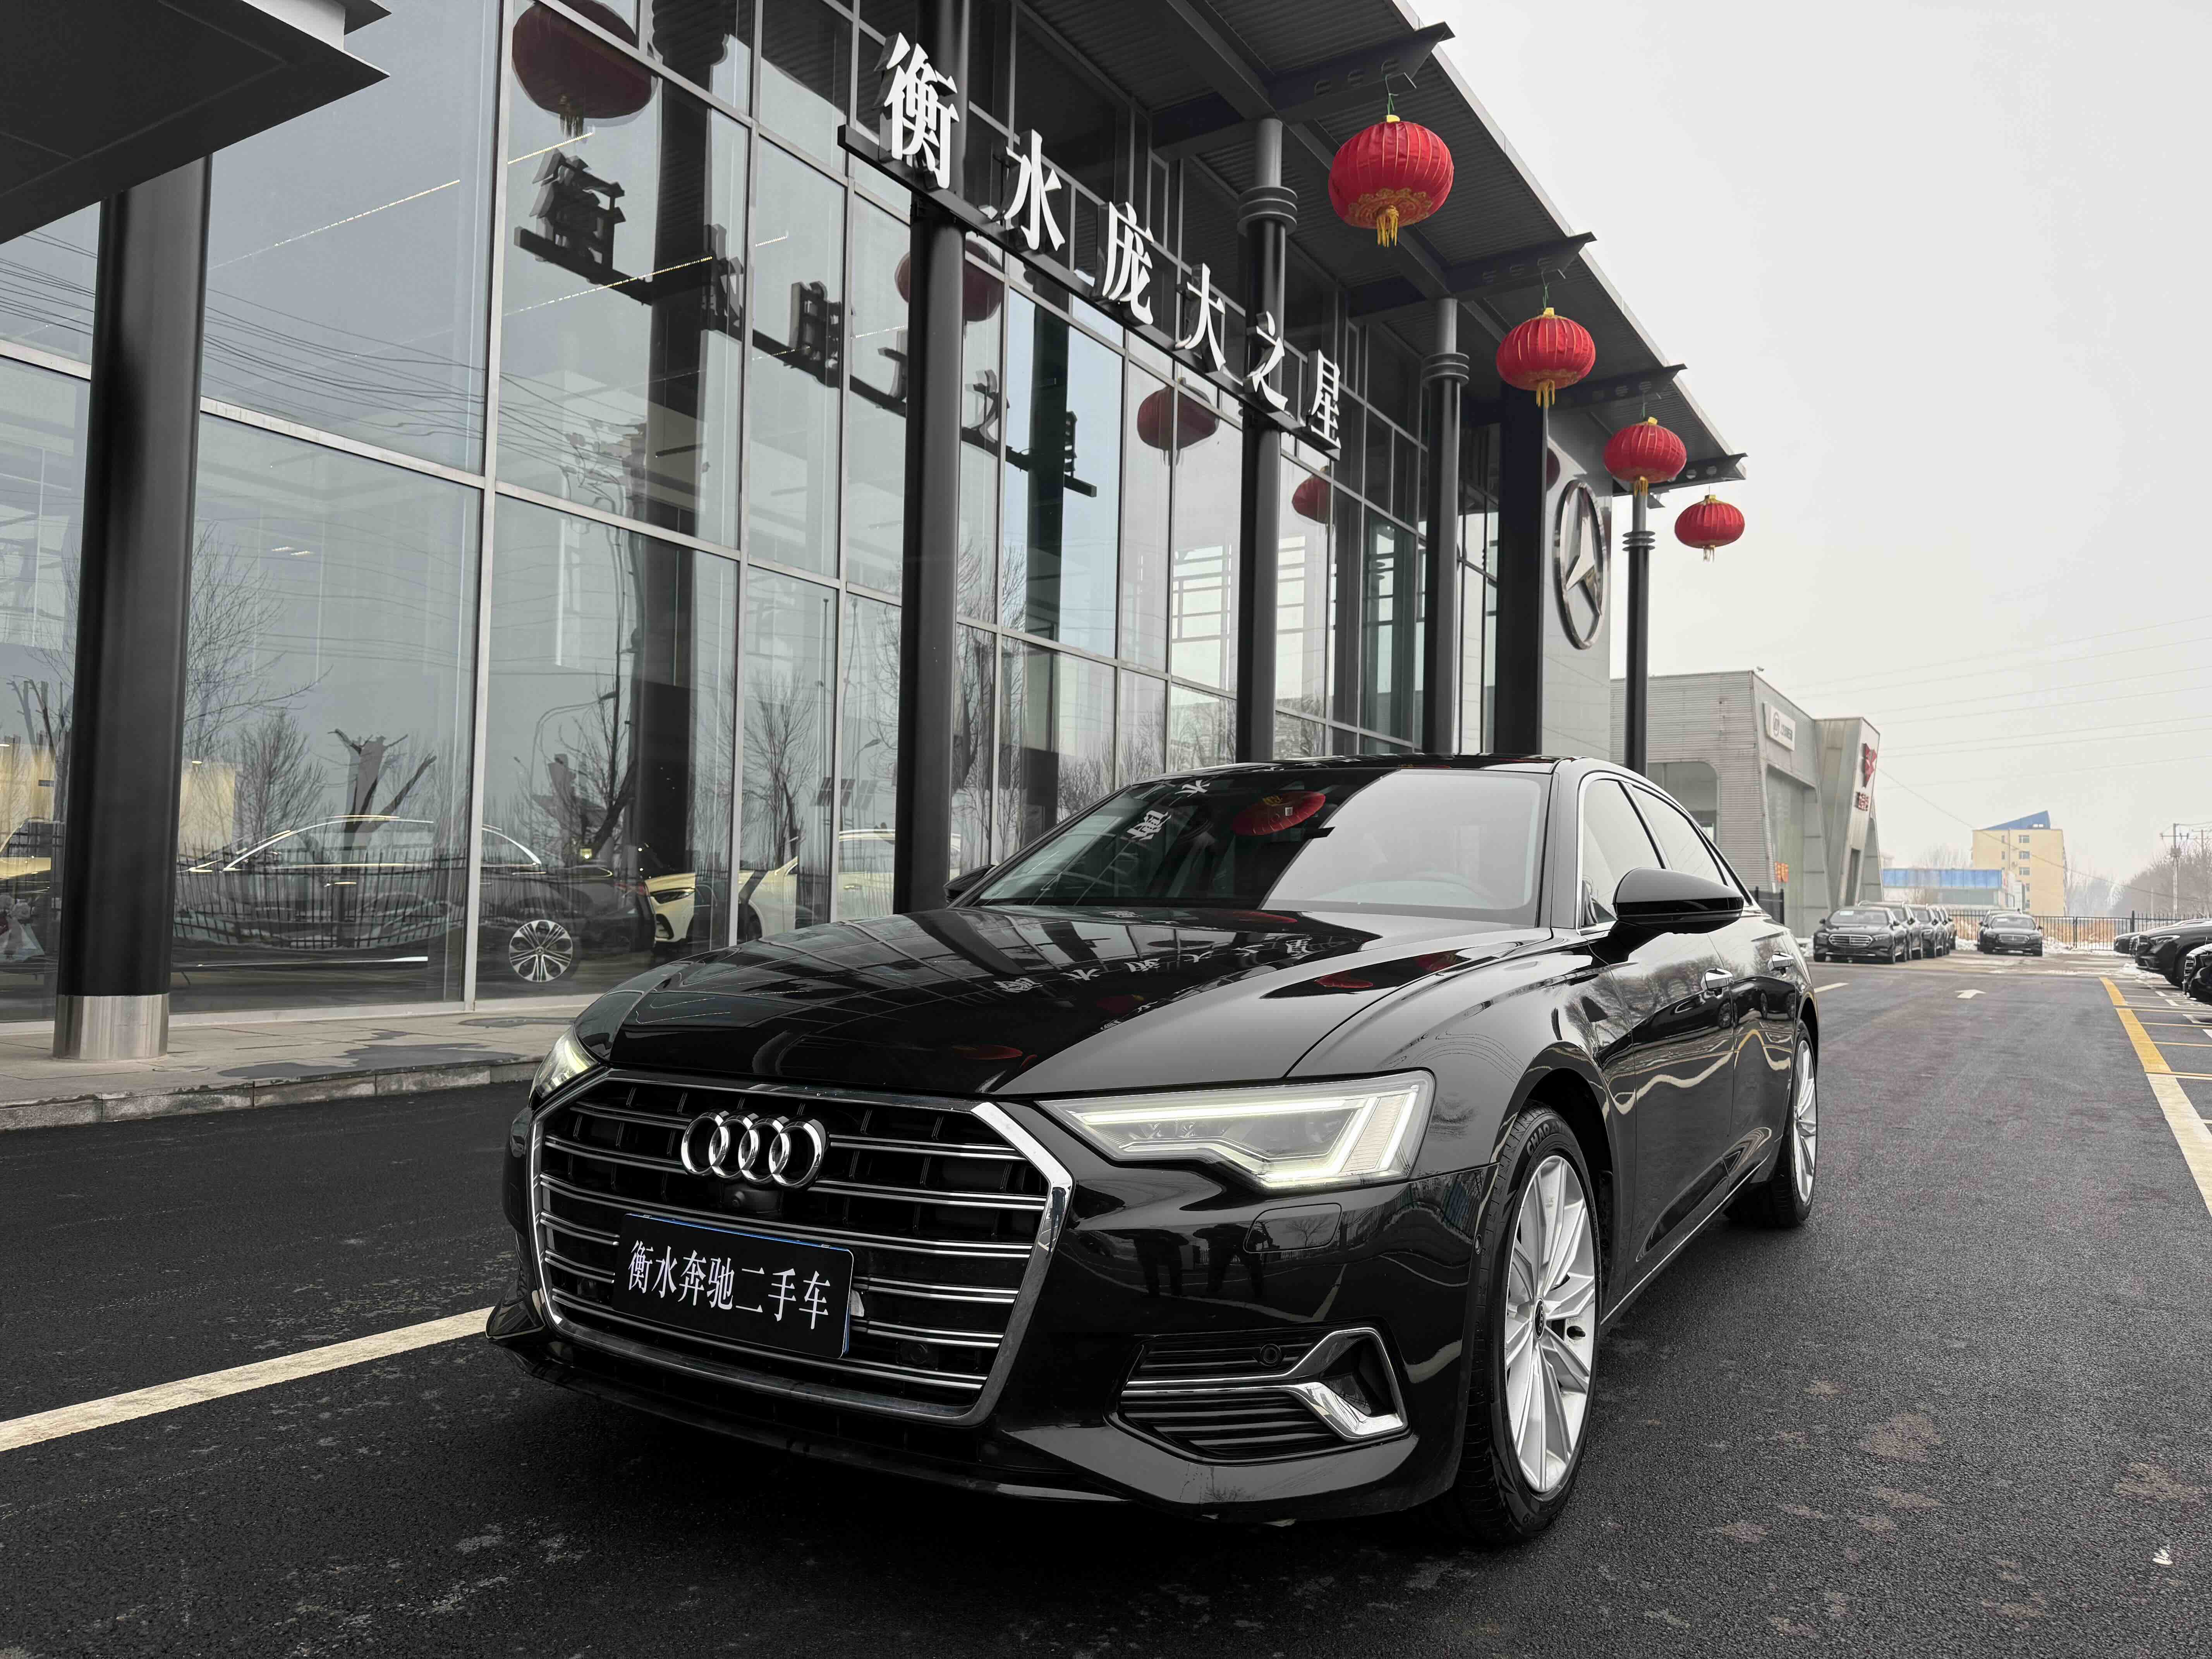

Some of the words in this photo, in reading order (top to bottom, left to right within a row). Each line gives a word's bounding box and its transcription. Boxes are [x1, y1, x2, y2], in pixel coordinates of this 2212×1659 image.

[884, 32, 1341, 449] 衡水庞大之星
[628, 1240, 831, 1329] 衡水奔驰二手车
